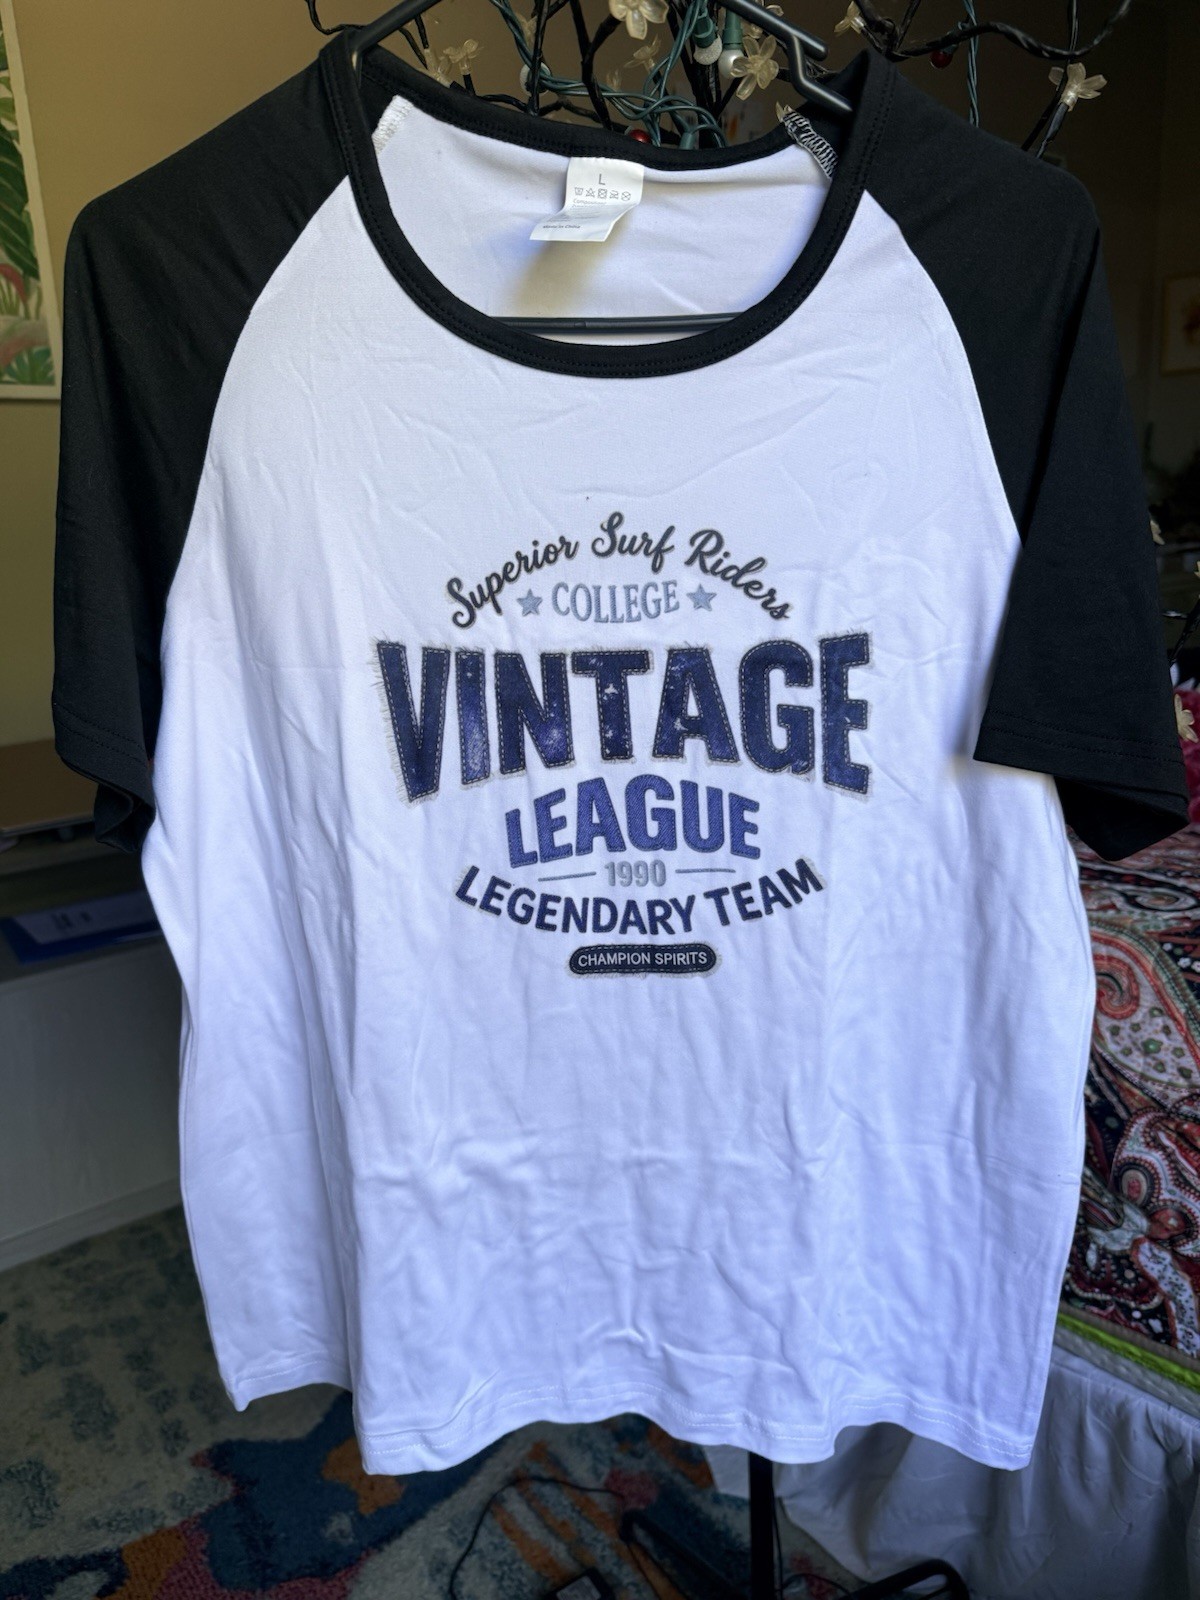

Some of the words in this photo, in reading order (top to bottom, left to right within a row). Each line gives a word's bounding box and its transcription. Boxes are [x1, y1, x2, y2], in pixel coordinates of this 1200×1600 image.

[598, 173, 606, 186] L
[447, 535, 579, 628] Superior
[591, 511, 675, 574] Surf
[684, 529, 790, 619] Riders
[551, 580, 680, 623] COLLEGE
[374, 632, 872, 804] VINTAGE
[505, 773, 761, 868] LEAGUE
[455, 865, 697, 935] LEGENDARY
[703, 858, 824, 926] TEAM
[604, 860, 667, 887] 1990
[578, 953, 650, 967] CHAMPION
[655, 952, 707, 966] SPIRITS
